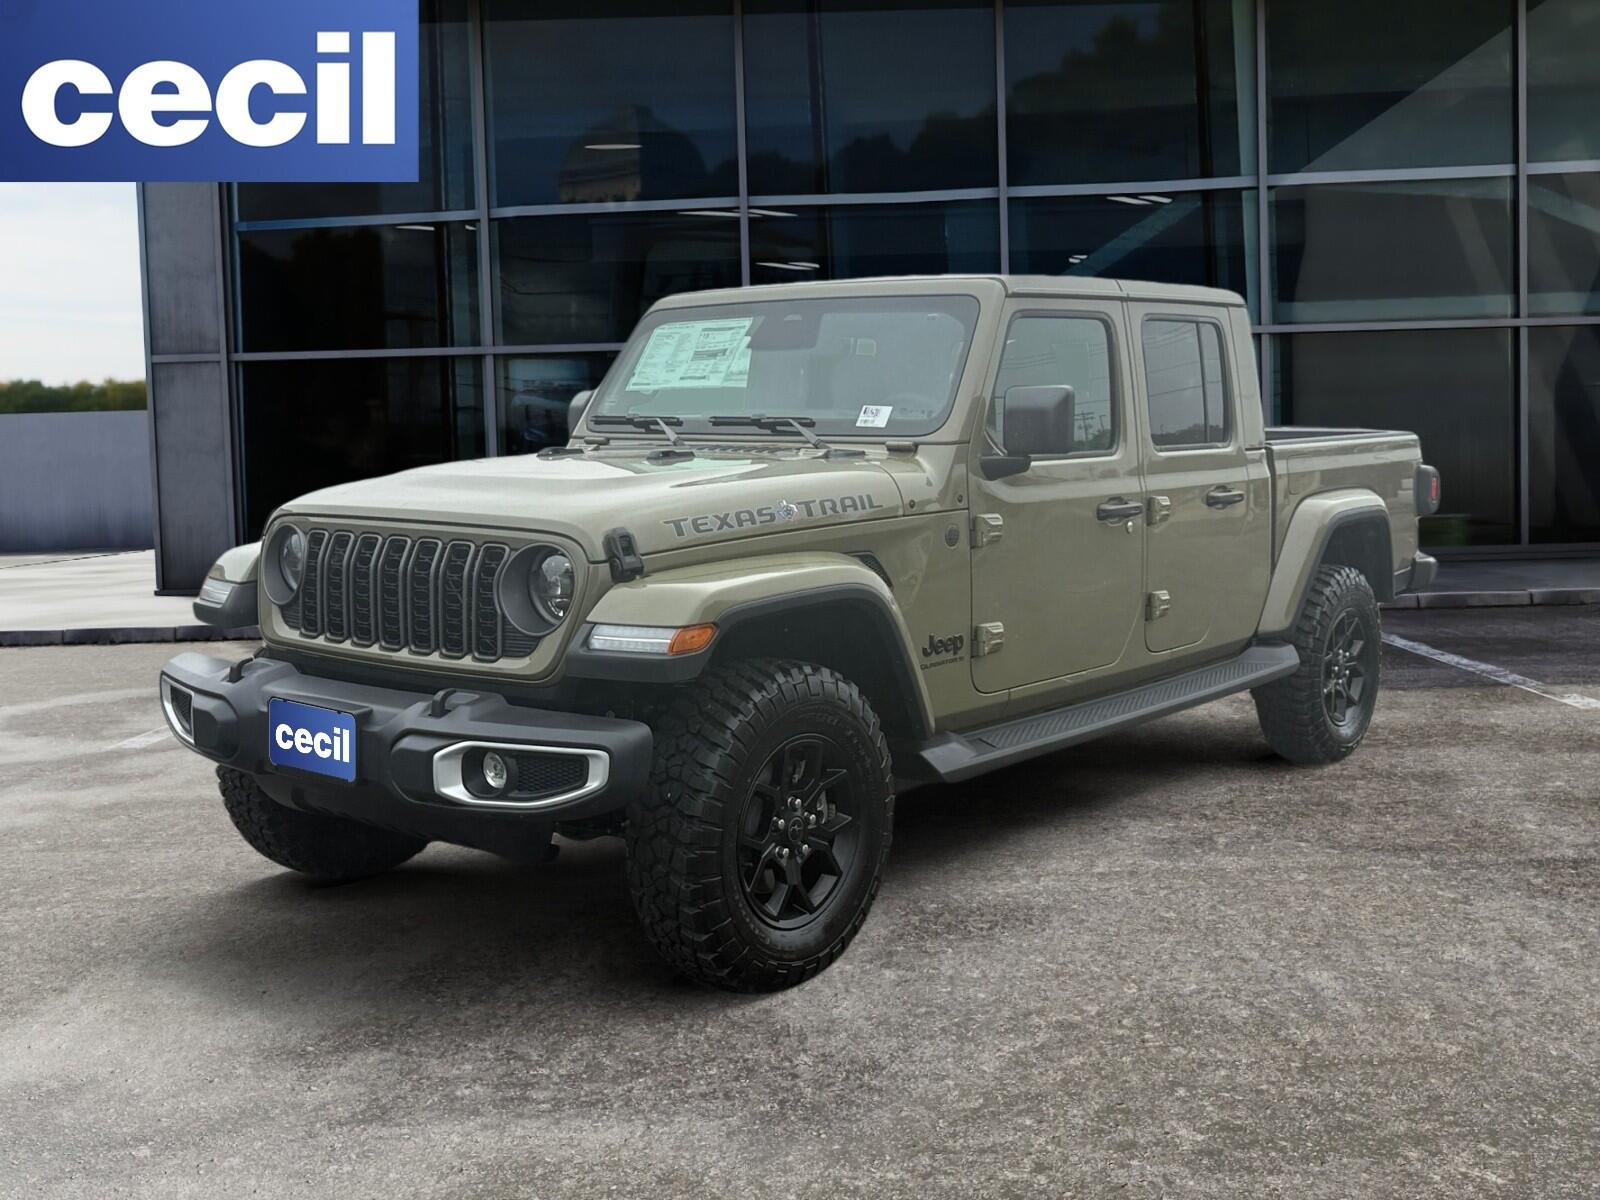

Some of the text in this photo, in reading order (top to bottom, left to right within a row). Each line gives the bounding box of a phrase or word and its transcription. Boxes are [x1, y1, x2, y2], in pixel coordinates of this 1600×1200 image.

[663, 494, 883, 537] TEXAS TRAIL
[922, 634, 964, 657] Jeep
[275, 723, 350, 763] cecil
